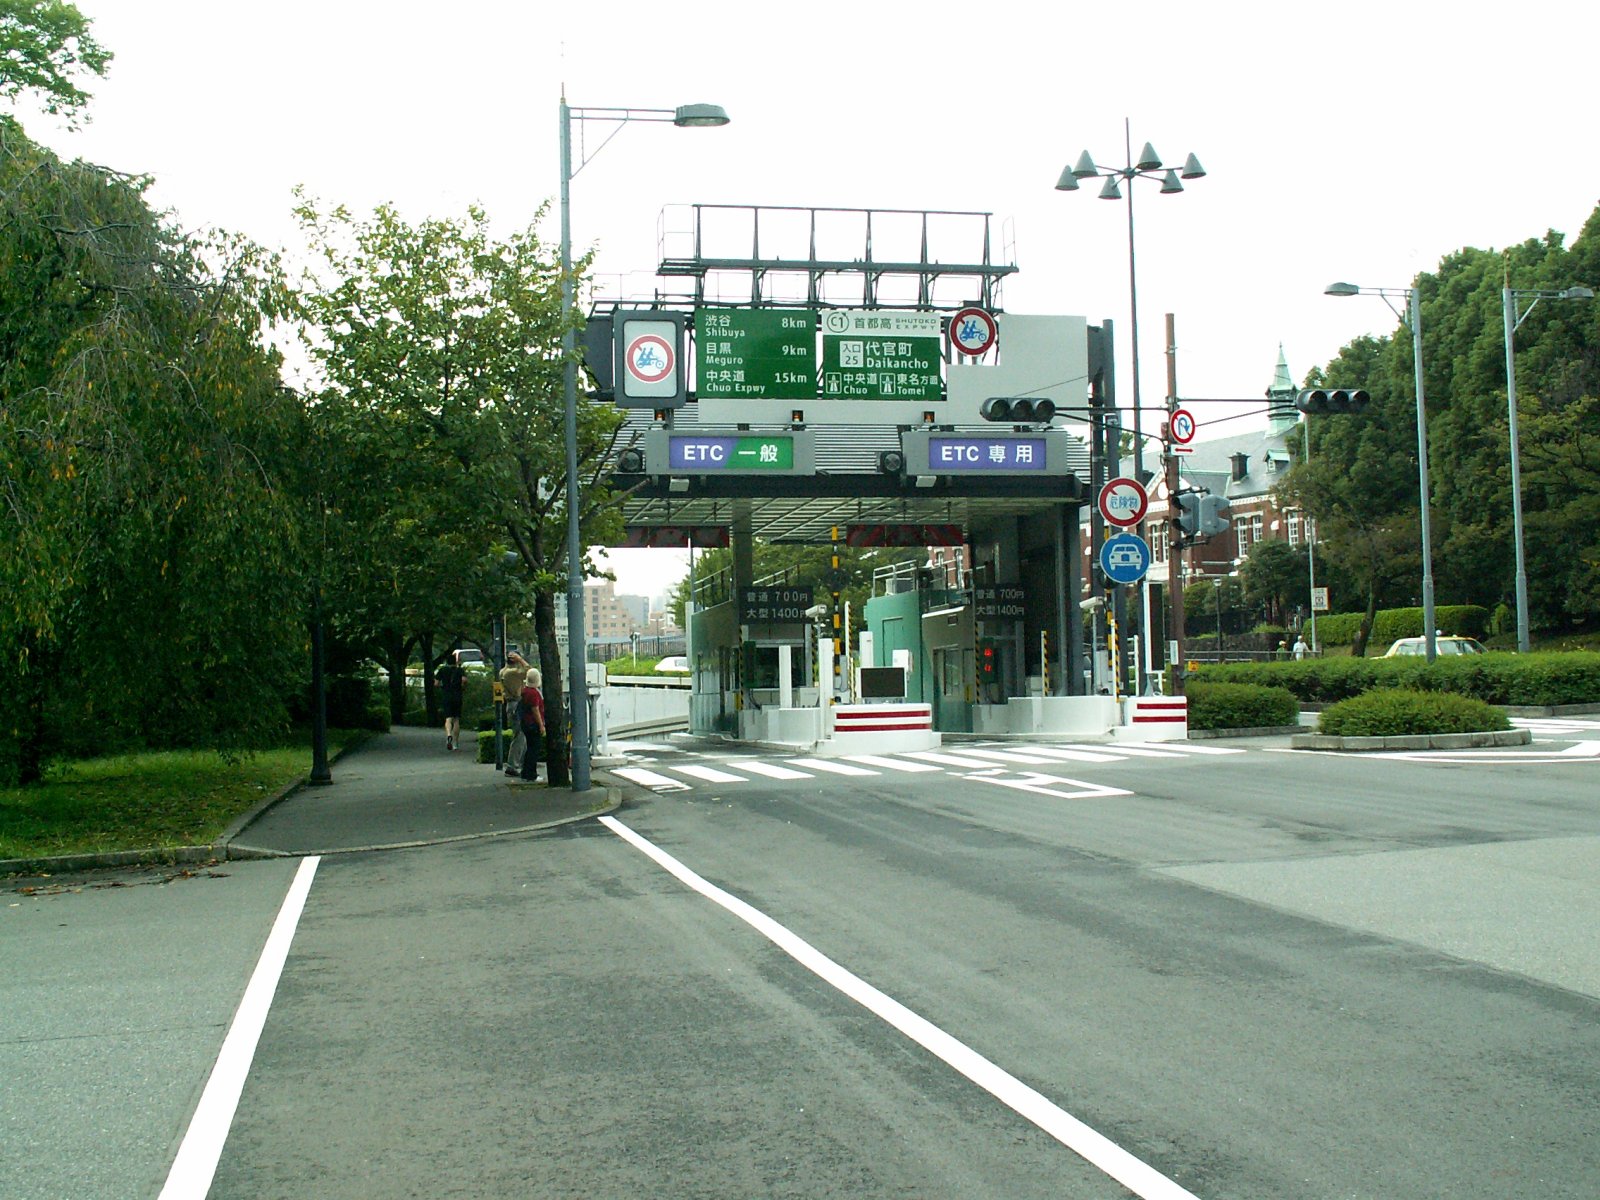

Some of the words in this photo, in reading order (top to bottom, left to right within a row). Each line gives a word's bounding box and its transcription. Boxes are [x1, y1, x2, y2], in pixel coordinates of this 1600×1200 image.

[705, 314, 731, 327] 渋谷
[781, 317, 807, 328] 8km
[830, 316, 844, 329] C1
[854, 317, 892, 330] 首都高
[705, 327, 746, 338] Shibuya
[706, 342, 732, 354] 目黒
[782, 345, 807, 356] 9km
[843, 343, 861, 353] 入口
[866, 341, 913, 357] 代官町
[706, 355, 743, 366] Meguro
[845, 355, 859, 365] 25
[866, 357, 929, 369] Daikancho
[706, 369, 745, 382] 中央道
[774, 372, 808, 383] 15km
[843, 372, 878, 385] 中央道
[897, 373, 938, 385] 東名方面
[706, 383, 732, 392] Chuo
[735, 383, 766, 394] Expwy
[843, 385, 868, 394] Chuo
[897, 386, 926, 395] Tomei
[684, 444, 723, 461] ETC
[738, 444, 778, 463] 一般
[941, 446, 979, 461] ETC
[988, 444, 1033, 463] 専用
